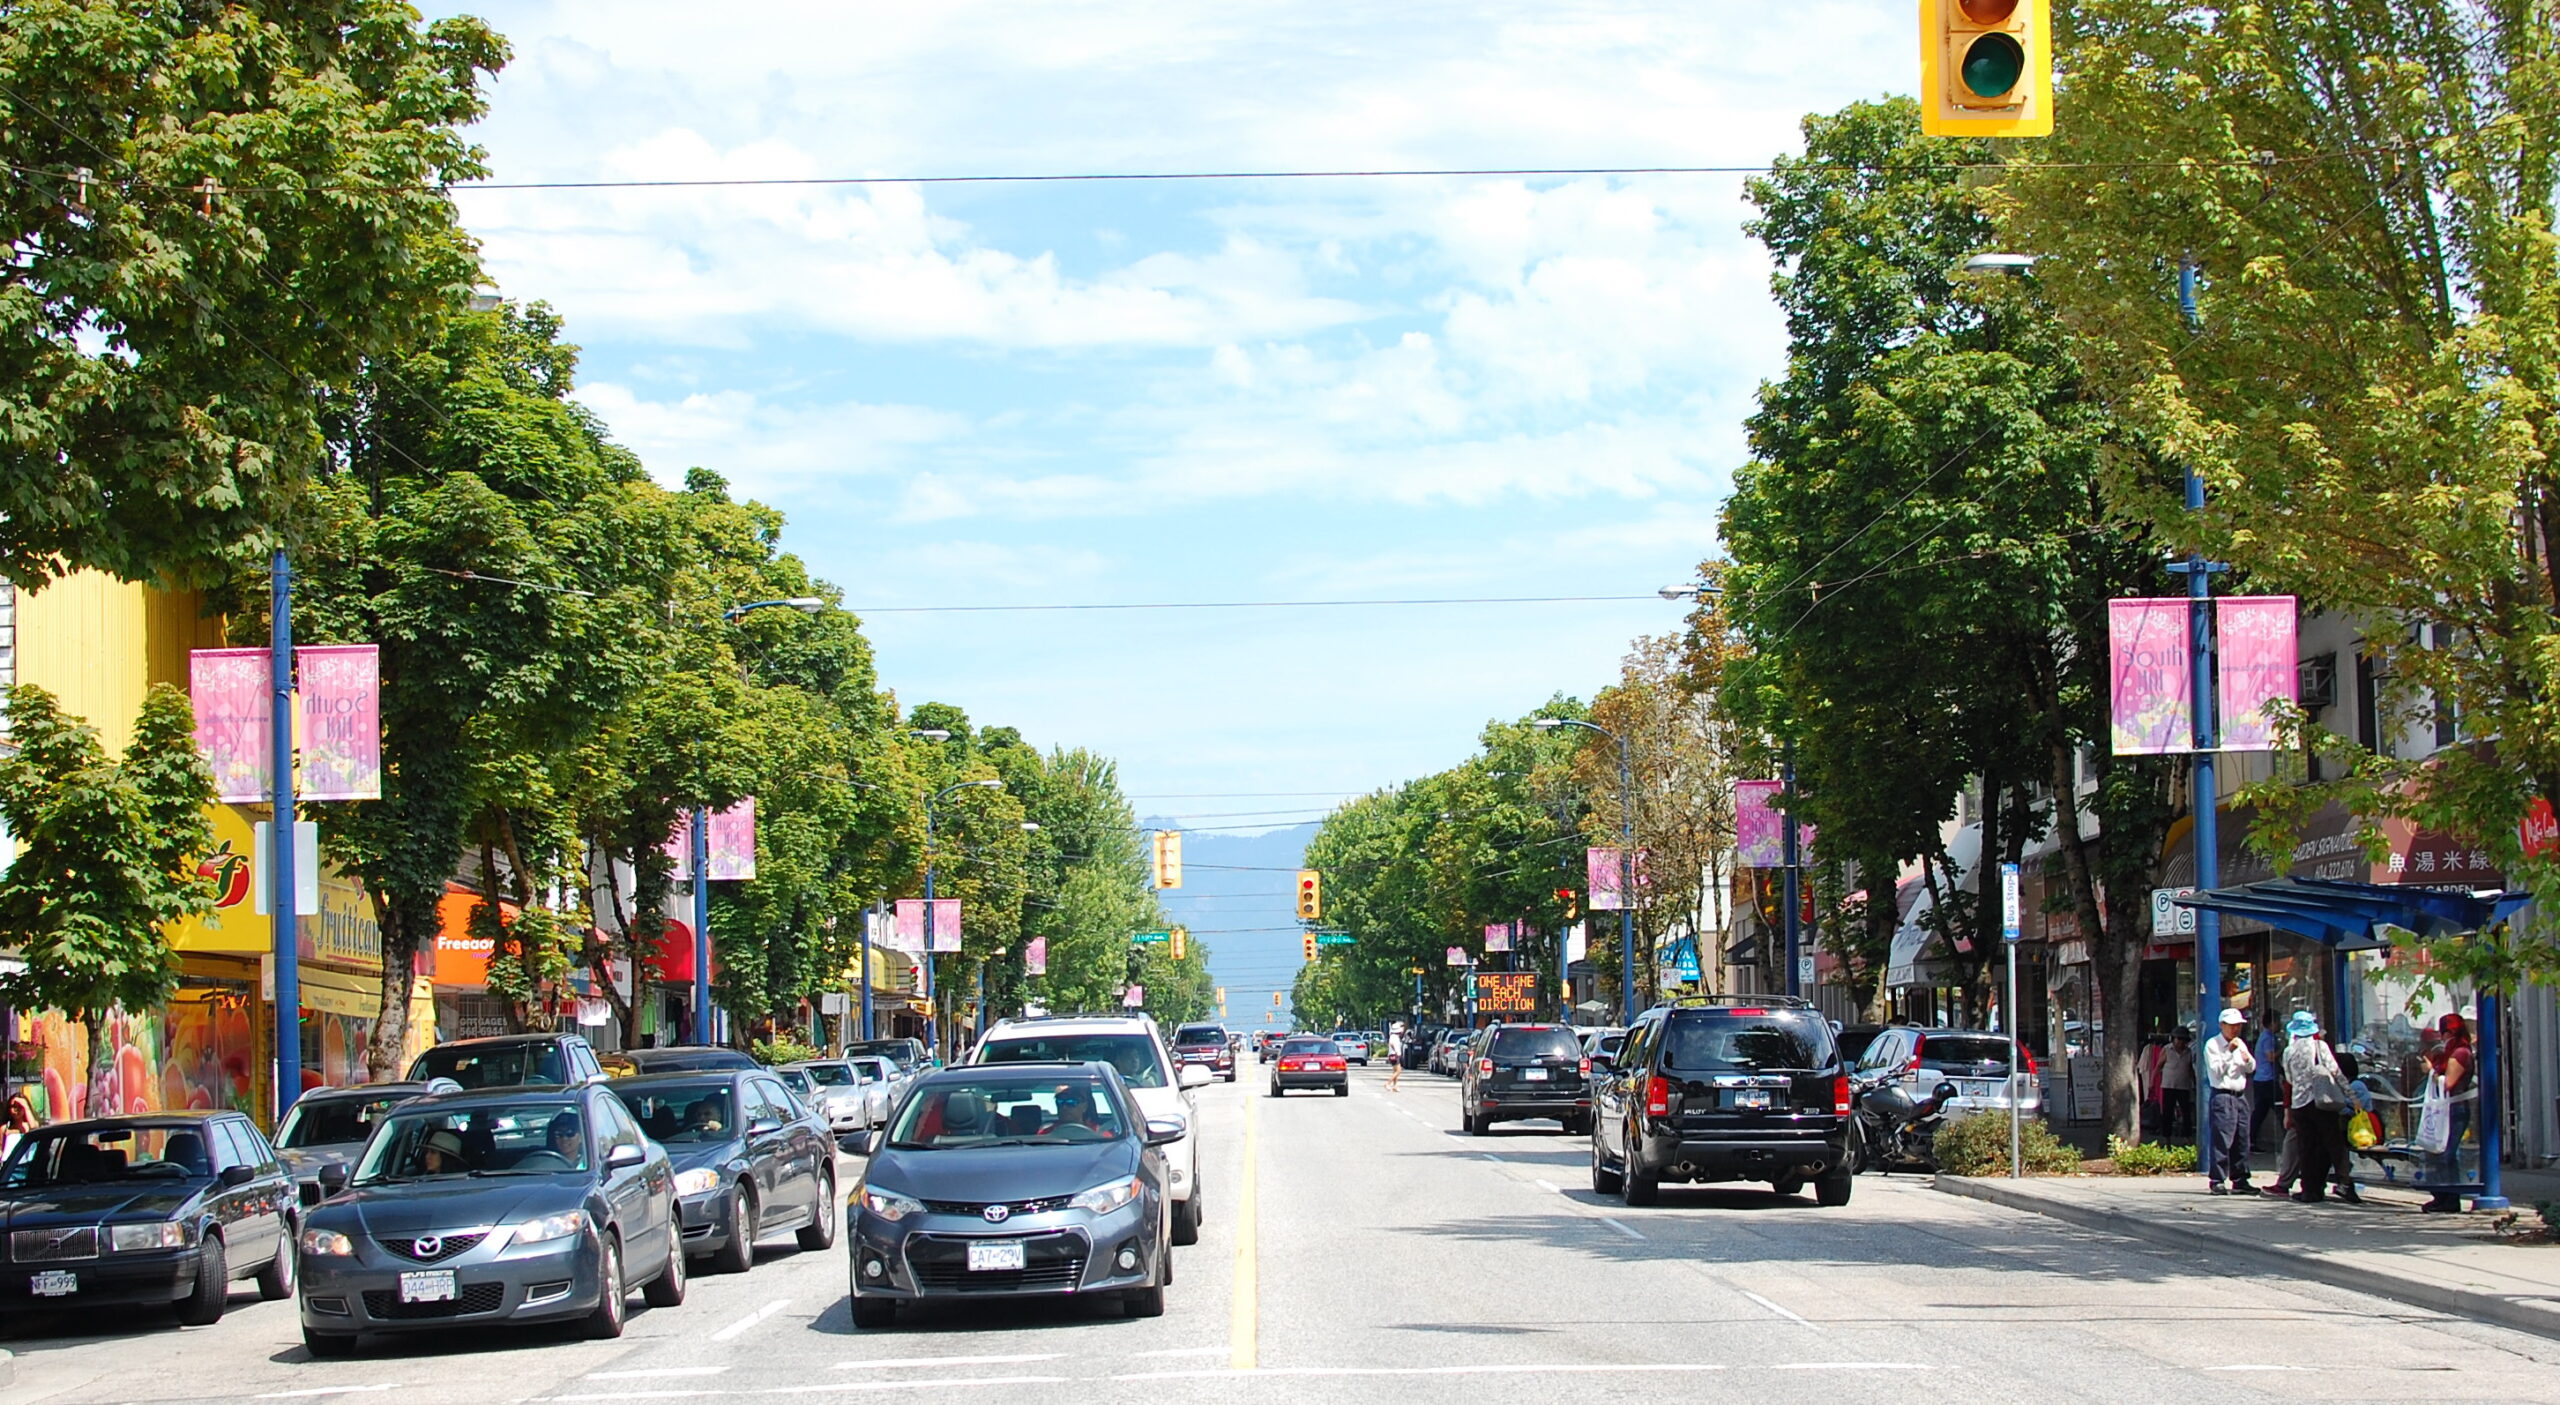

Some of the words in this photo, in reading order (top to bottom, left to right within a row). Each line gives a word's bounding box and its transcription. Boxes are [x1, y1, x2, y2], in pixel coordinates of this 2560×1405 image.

[2117, 643, 2182, 668] South
[1479, 975, 1500, 987] ONE
[1506, 975, 1534, 987] LANE
[1492, 987, 1521, 999] EACH
[1479, 998, 1534, 1010] DIRCTION
